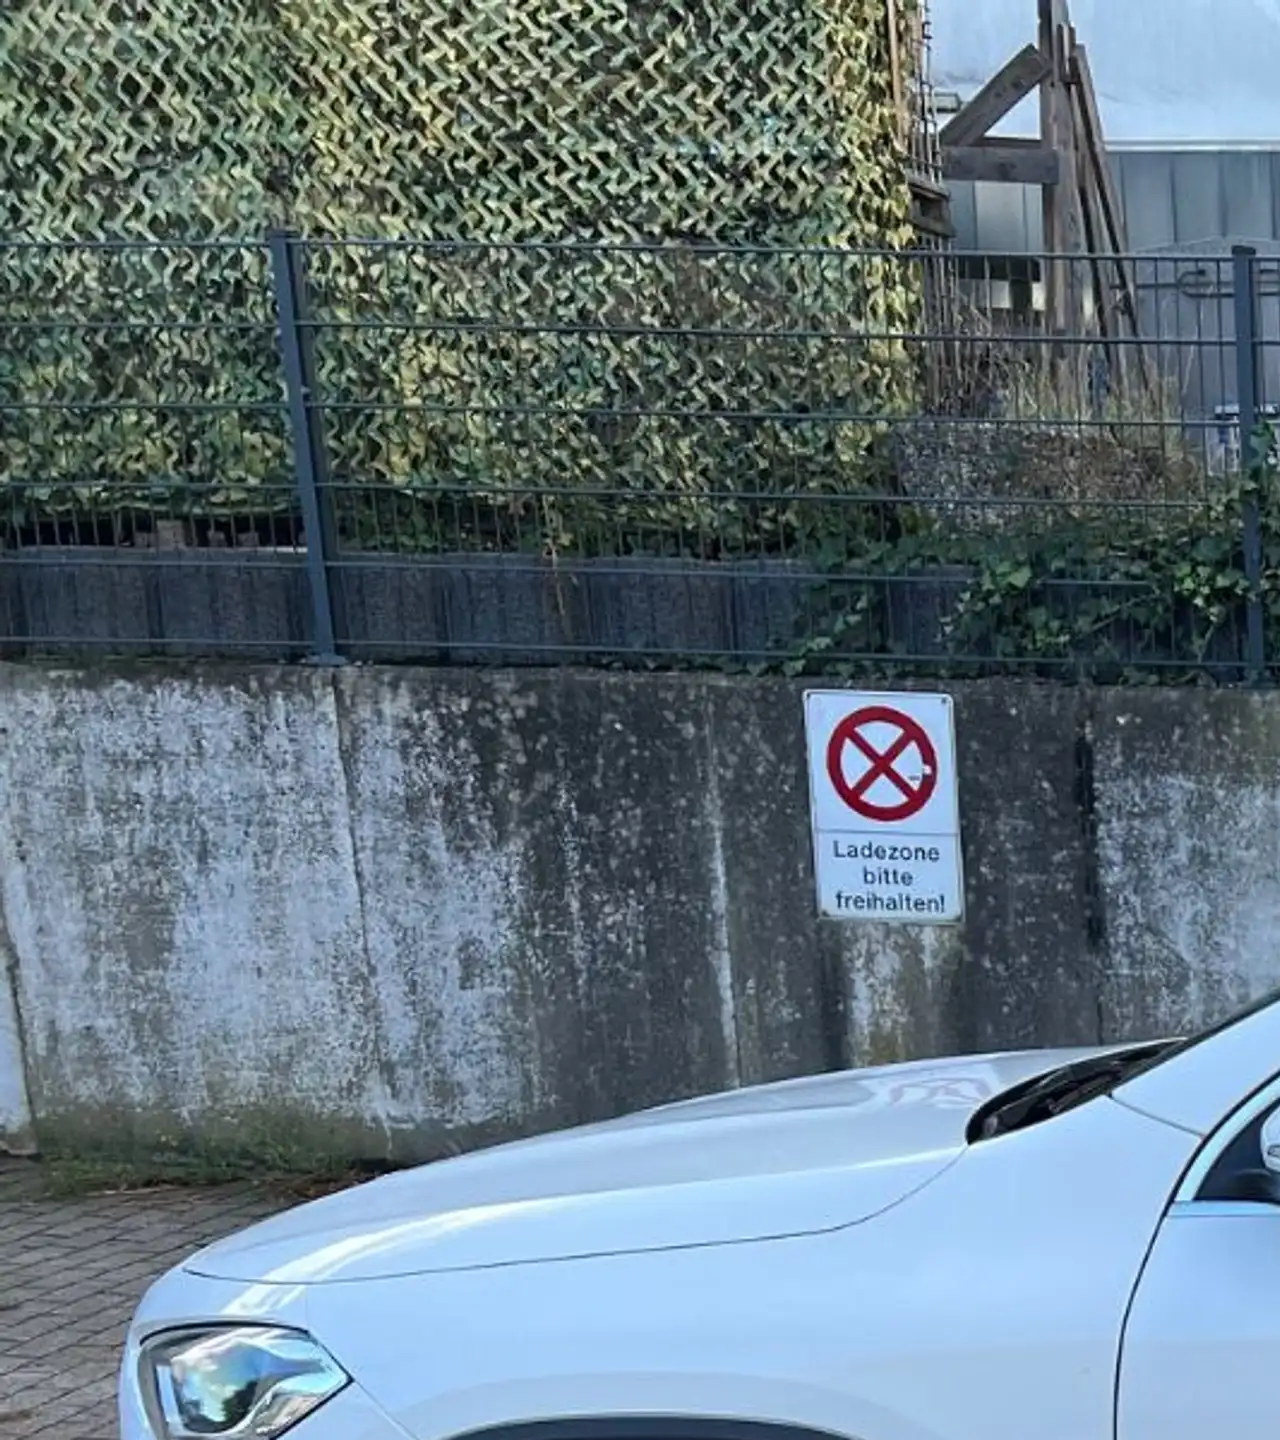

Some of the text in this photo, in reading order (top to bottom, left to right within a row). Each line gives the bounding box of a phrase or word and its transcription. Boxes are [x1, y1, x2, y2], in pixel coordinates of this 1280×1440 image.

[833, 840, 940, 863] Ladezone
[863, 866, 914, 886] bitte
[835, 892, 945, 913] freihalten!
